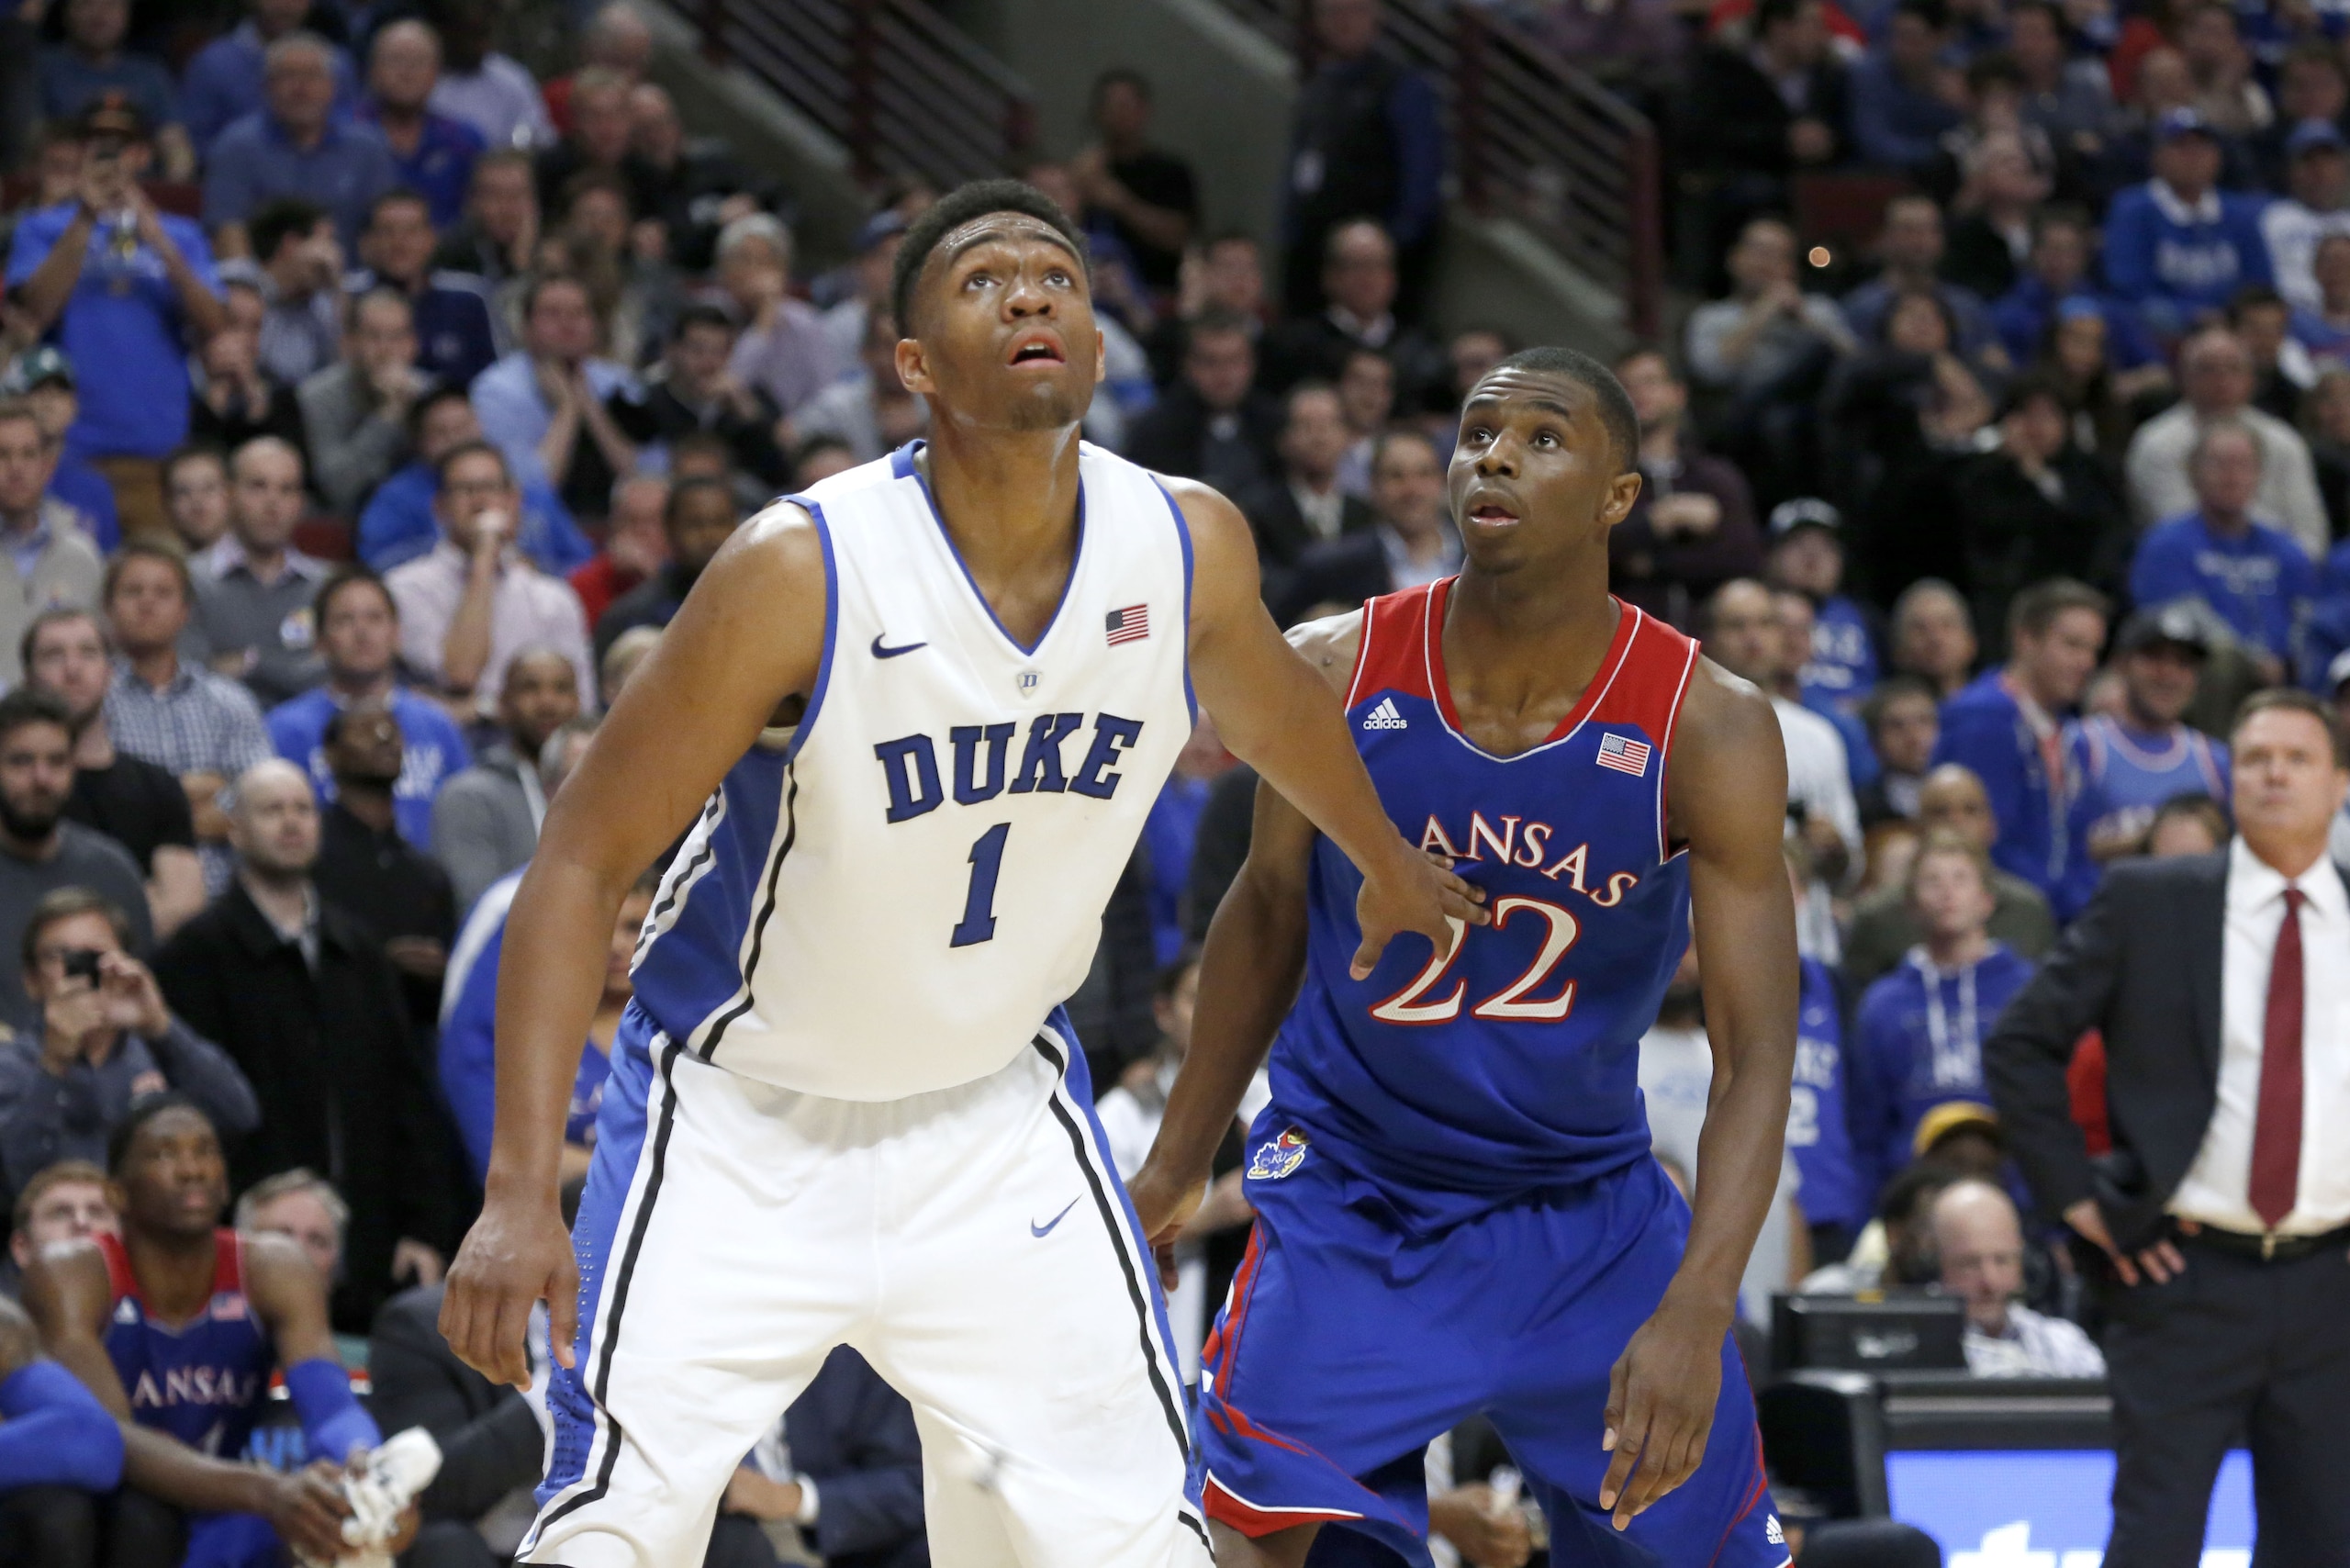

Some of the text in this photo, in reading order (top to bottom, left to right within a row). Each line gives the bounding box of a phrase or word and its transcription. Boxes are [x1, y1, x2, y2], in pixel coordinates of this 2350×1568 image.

[873, 712, 1145, 823] DUKE
[1362, 718, 1408, 730] adidas
[949, 822, 1012, 947] 1
[1420, 810, 1639, 908] ANSAS
[1369, 894, 1582, 1025] 22
[1271, 1151, 1288, 1164] KU
